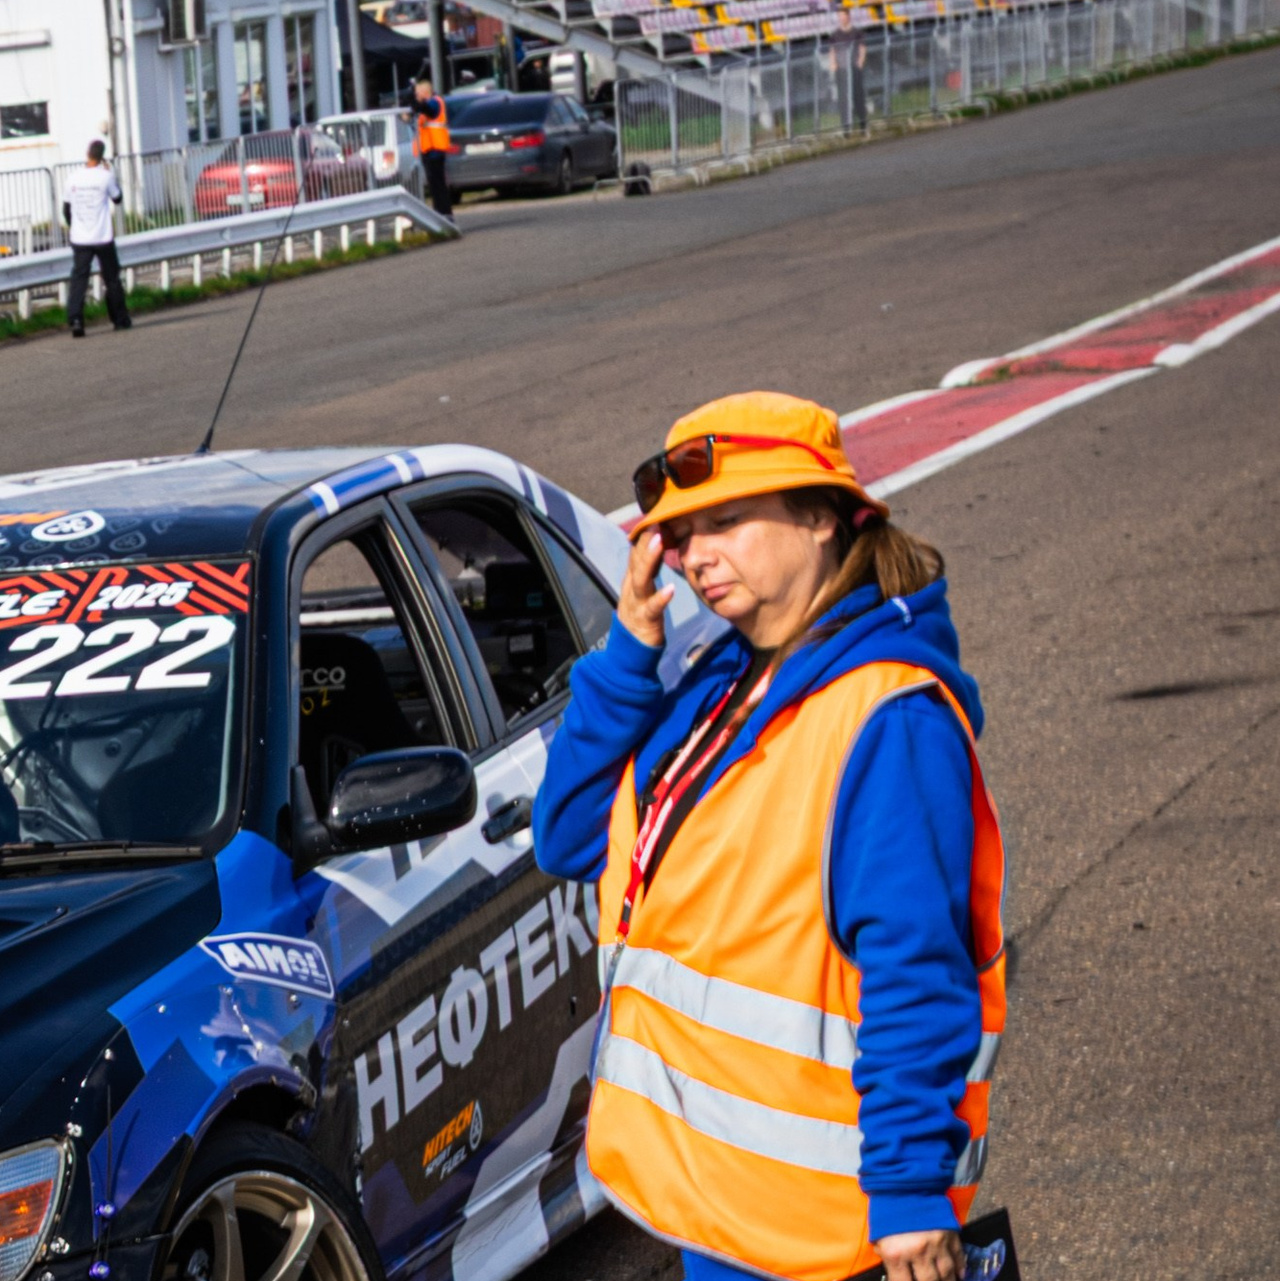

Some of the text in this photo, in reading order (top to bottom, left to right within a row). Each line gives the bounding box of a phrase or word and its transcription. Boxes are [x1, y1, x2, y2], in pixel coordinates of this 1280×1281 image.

[87, 581, 194, 611] 2025
[218, 942, 327, 987] AIMOL
[422, 1100, 474, 1168] HITECH
[440, 1145, 468, 1180] FUEL
